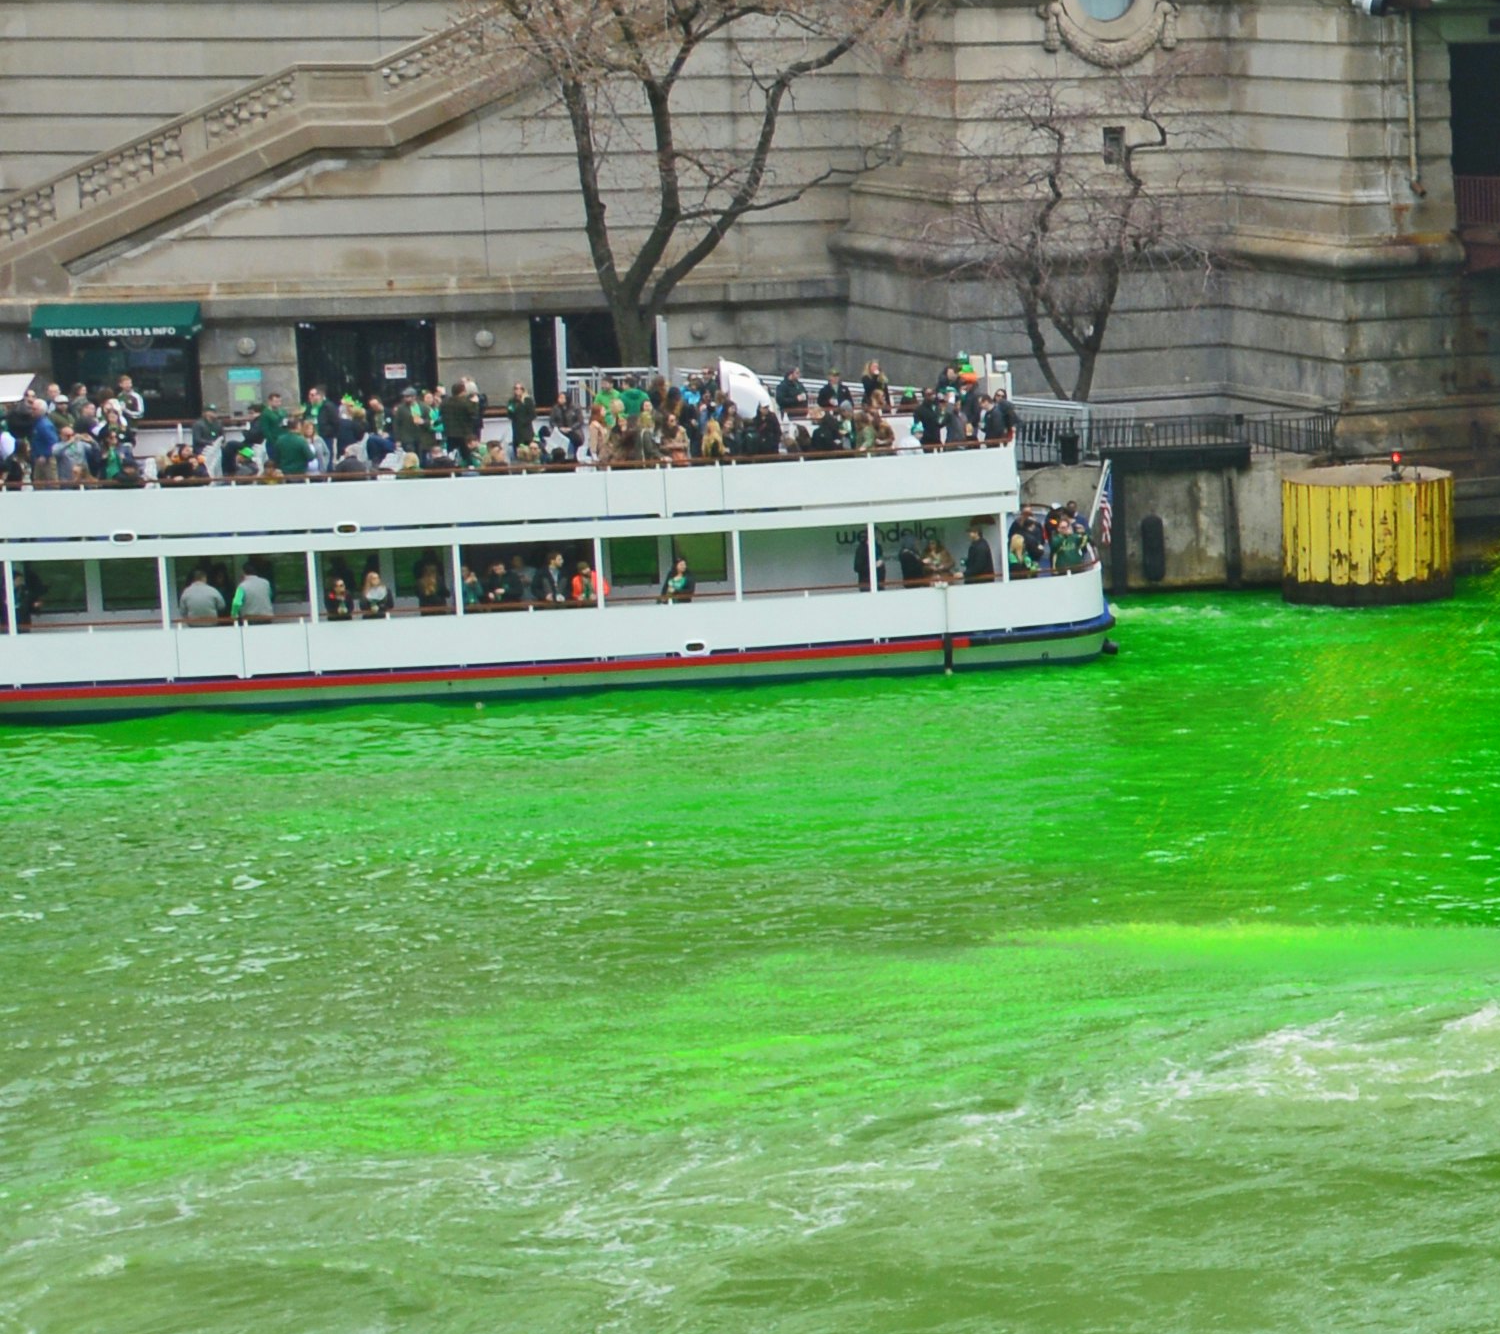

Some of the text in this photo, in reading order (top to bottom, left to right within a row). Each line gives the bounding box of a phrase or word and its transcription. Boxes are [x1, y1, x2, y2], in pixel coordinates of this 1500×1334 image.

[44, 326, 176, 338] WENDELLA TICKETS & INFO
